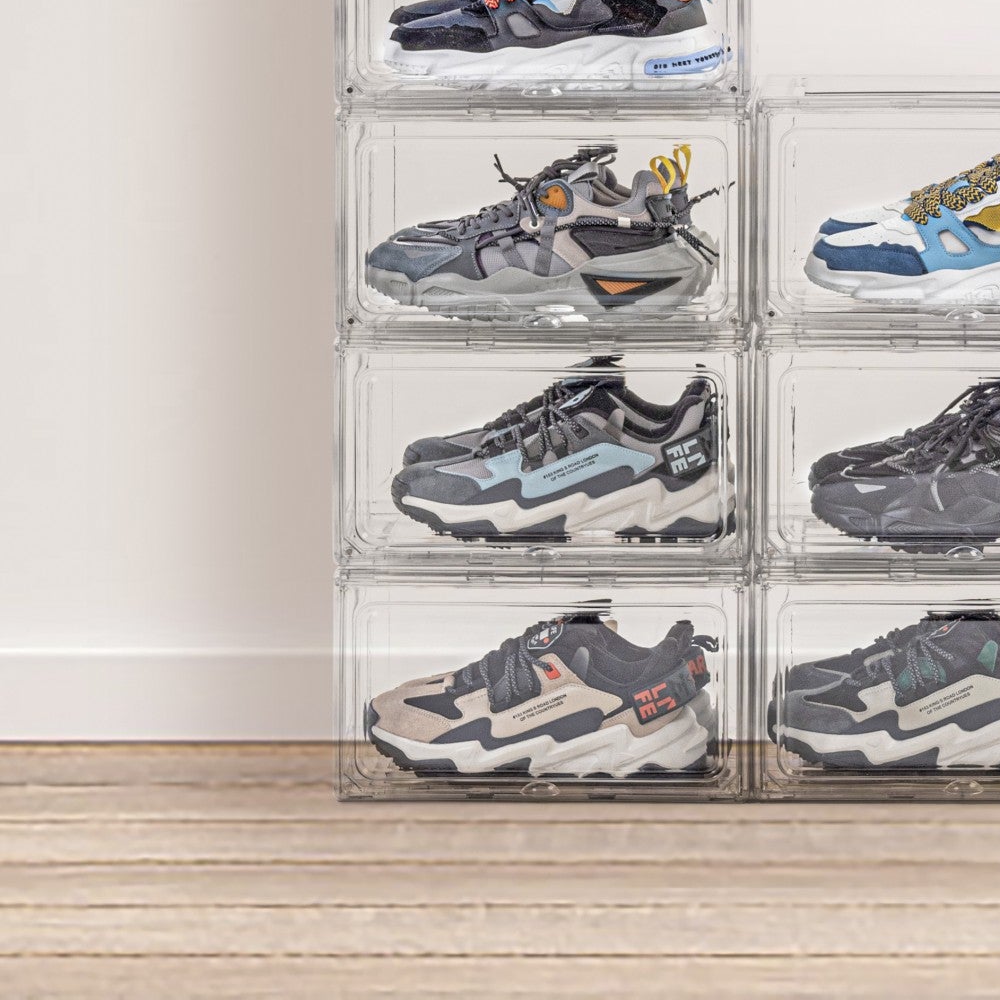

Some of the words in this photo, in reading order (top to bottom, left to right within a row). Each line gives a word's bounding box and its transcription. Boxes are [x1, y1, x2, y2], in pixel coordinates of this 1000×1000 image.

[567, 460, 580, 469] ROAD
[580, 452, 599, 463] LONDON
[548, 692, 567, 703] LONDON
[942, 692, 955, 701] ROAD
[955, 684, 974, 695] LONDON
